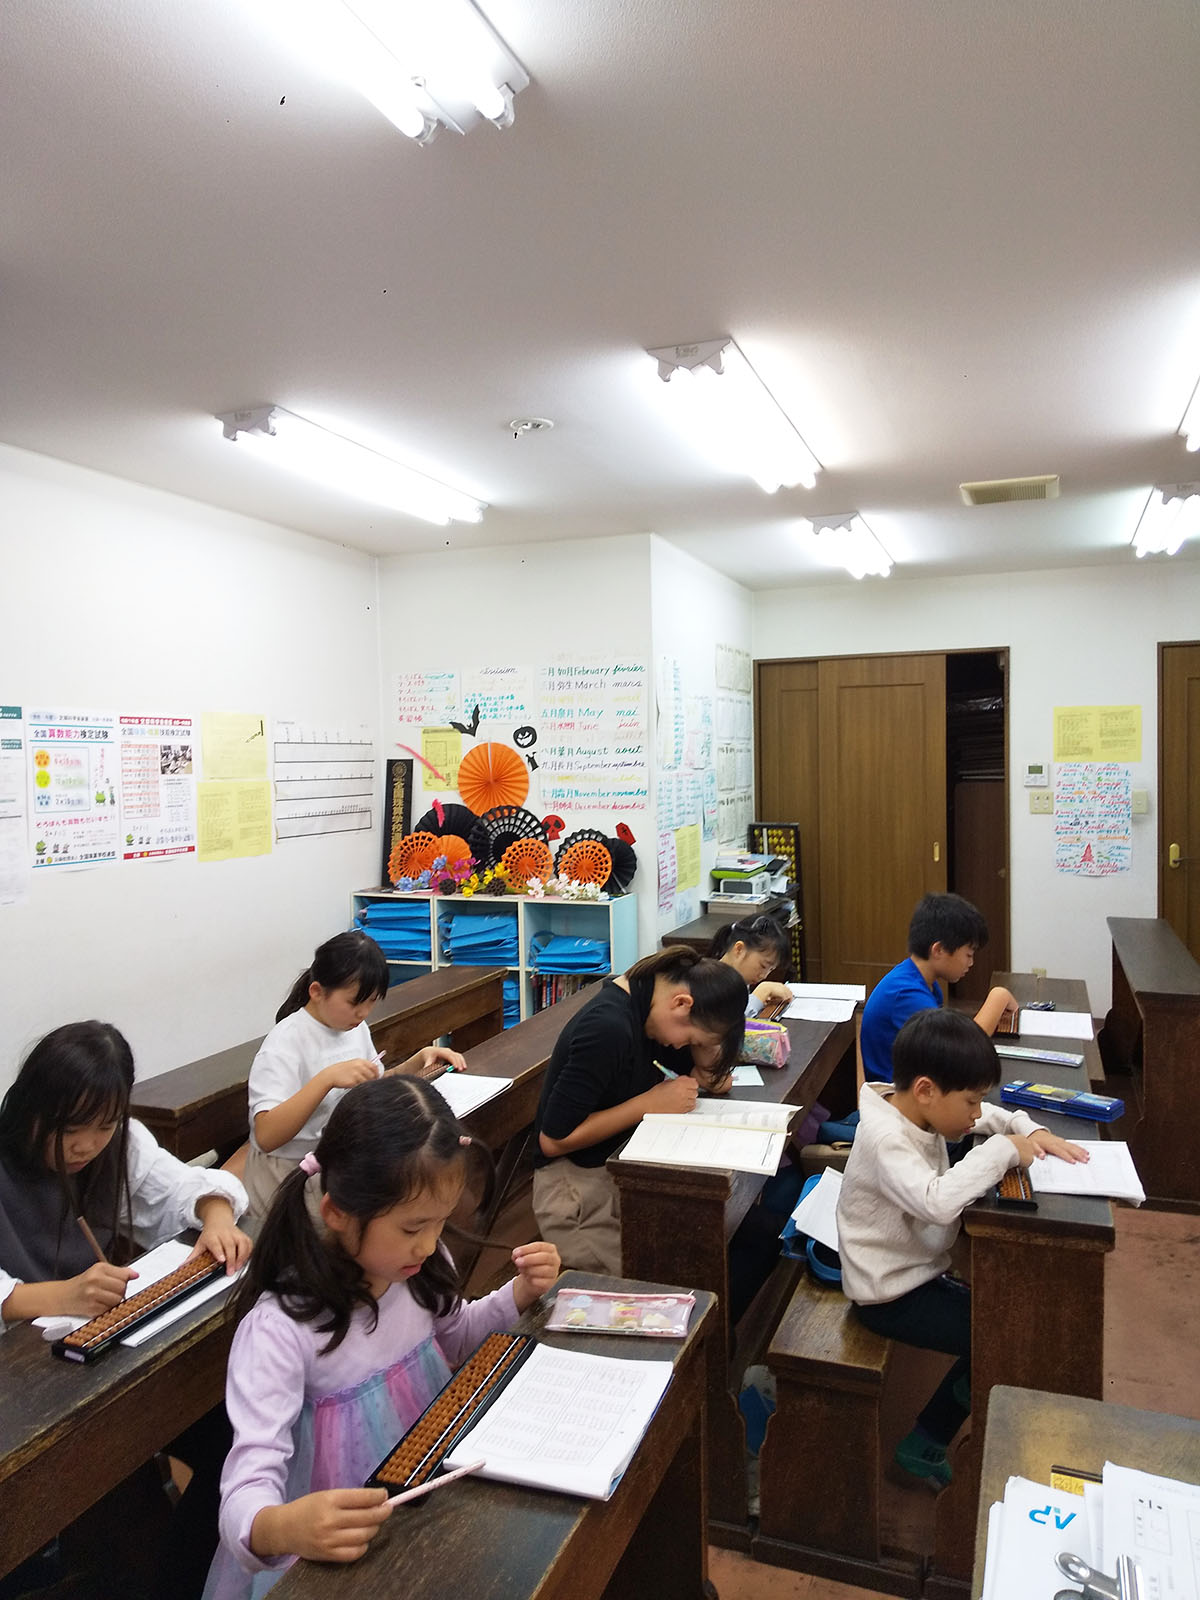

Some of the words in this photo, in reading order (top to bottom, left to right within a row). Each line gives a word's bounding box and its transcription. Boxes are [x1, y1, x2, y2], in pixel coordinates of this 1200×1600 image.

[574, 666, 610, 677] February
[575, 679, 606, 689] March
[578, 708, 604, 720] May
[576, 746, 608, 758] August
[574, 788, 612, 798] November
